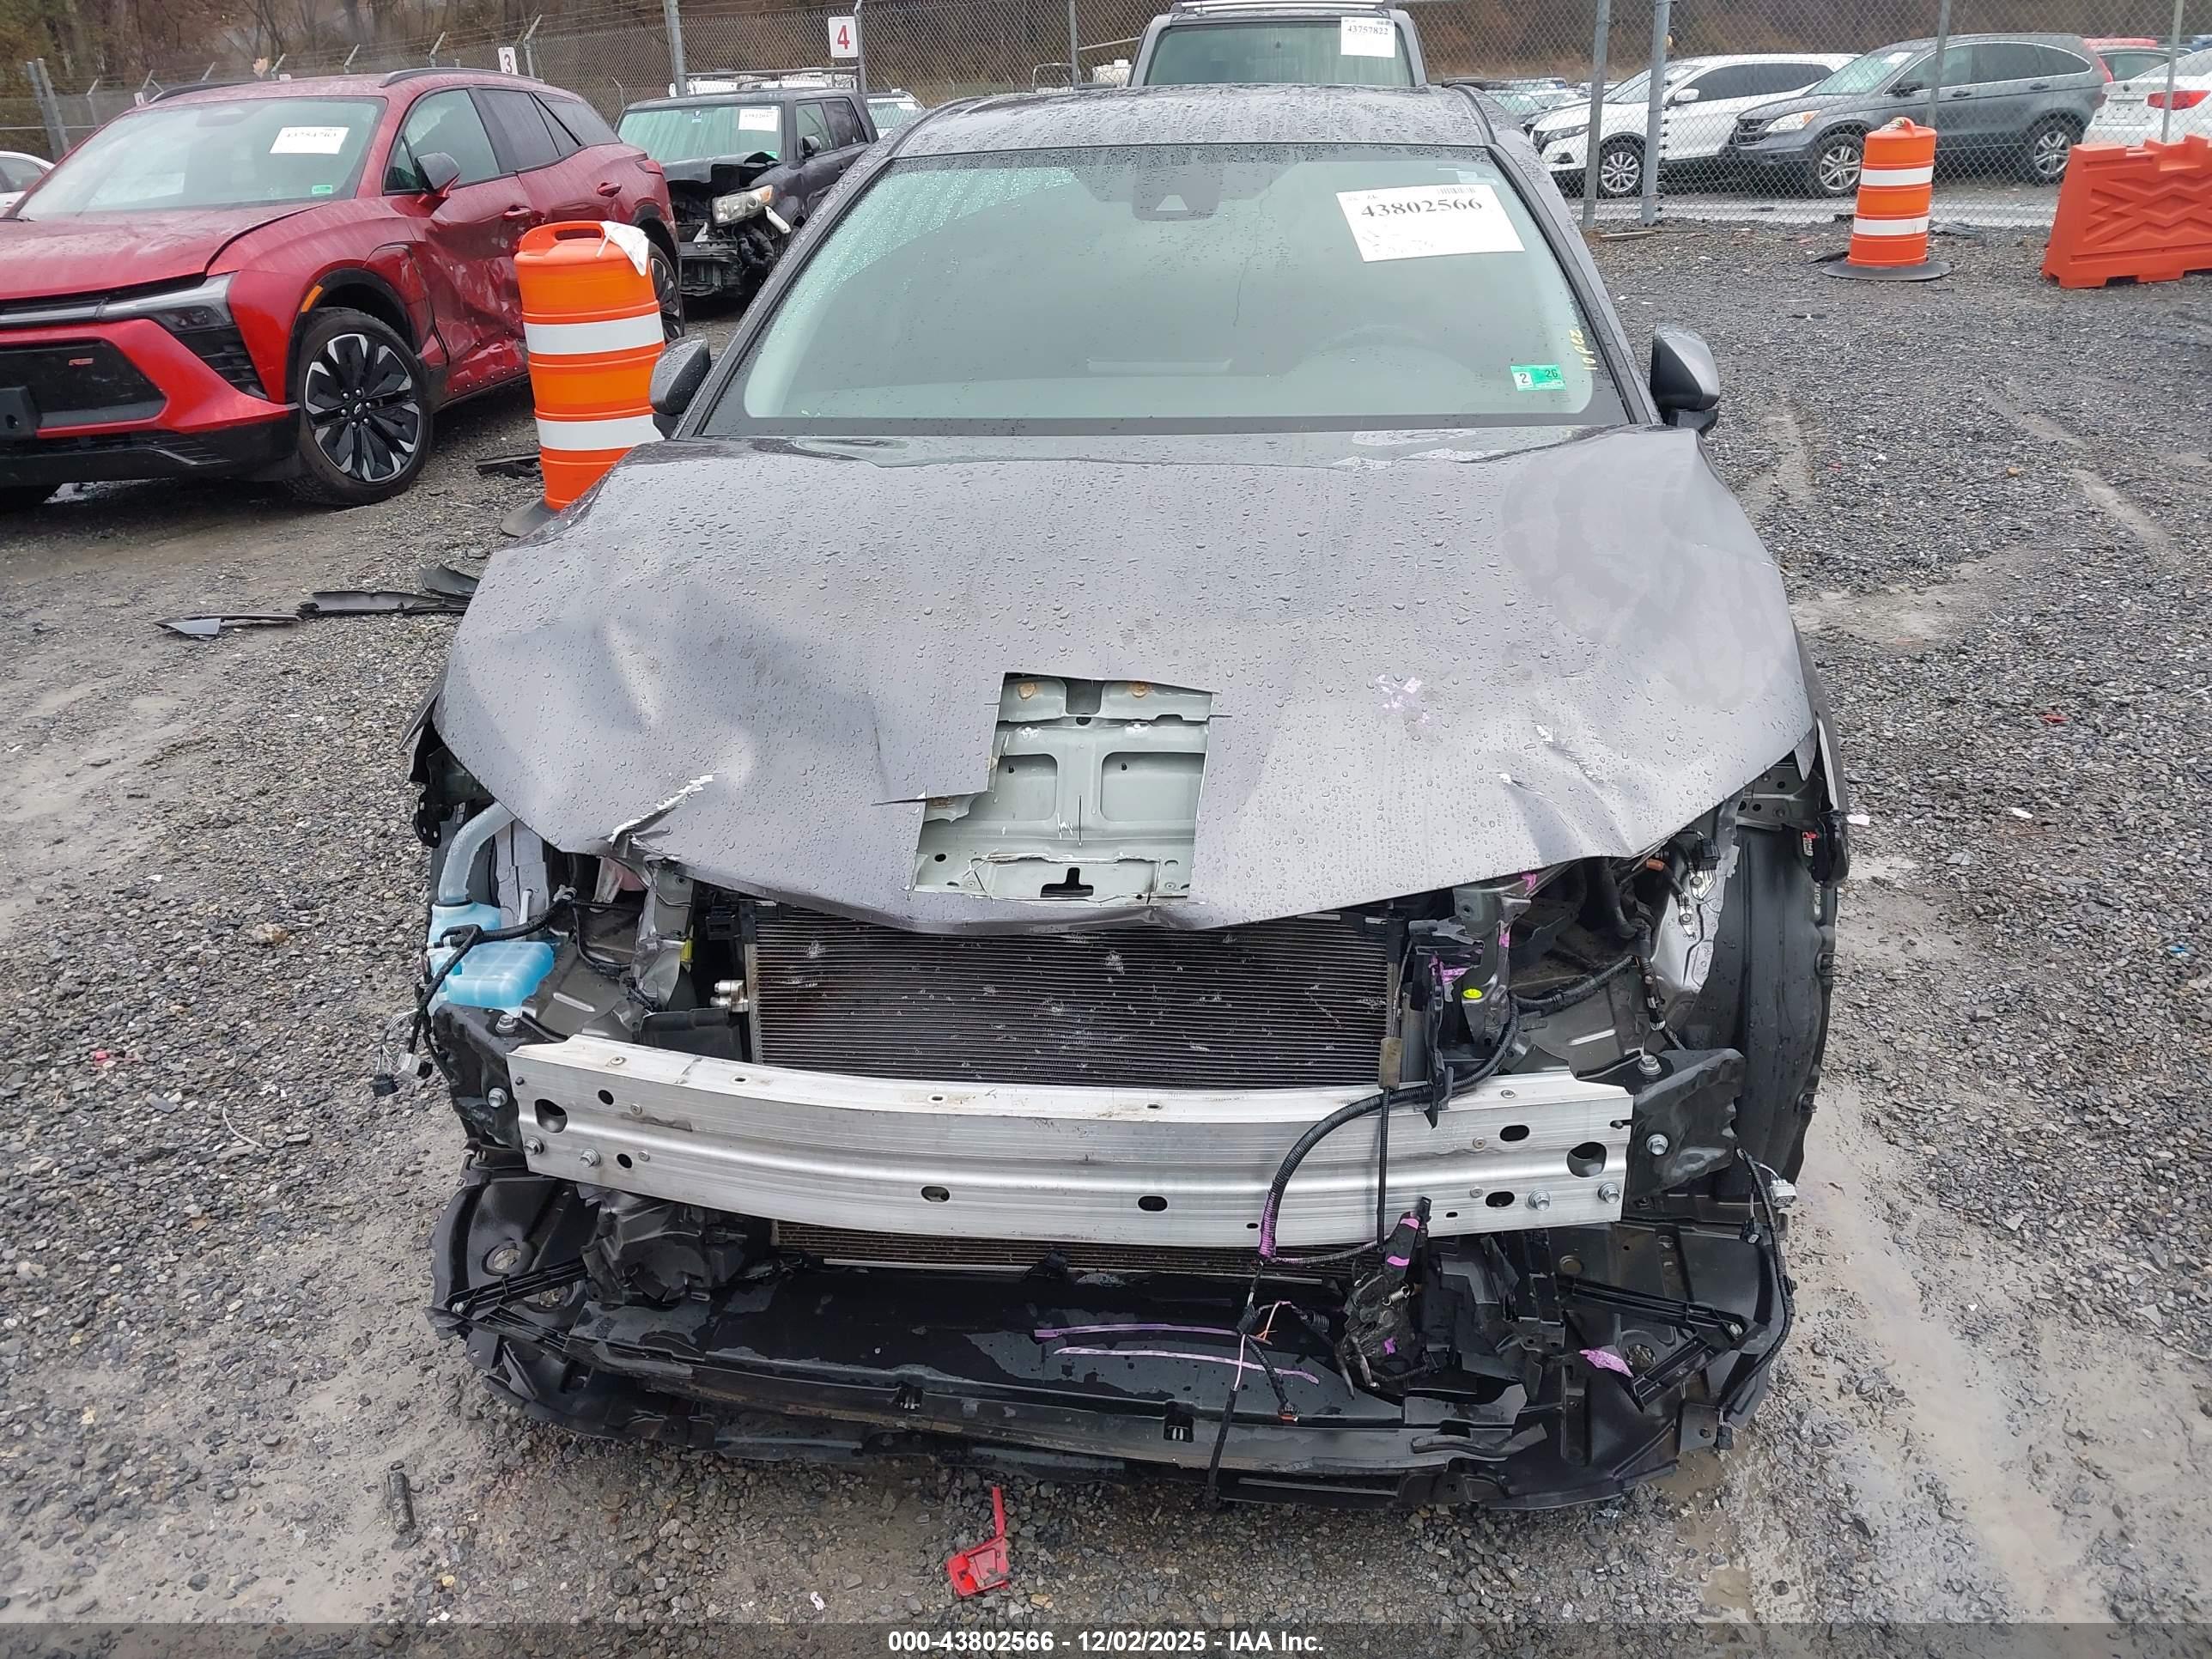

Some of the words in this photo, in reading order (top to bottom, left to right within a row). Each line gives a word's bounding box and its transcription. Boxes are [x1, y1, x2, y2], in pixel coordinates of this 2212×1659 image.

[837, 25, 850, 50] 4
[1347, 25, 1389, 35] 43757822
[504, 53, 513, 74] 3
[1361, 198, 1483, 217] 43802566
[1519, 373, 1528, 384] 2
[1545, 368, 1559, 379] 26
